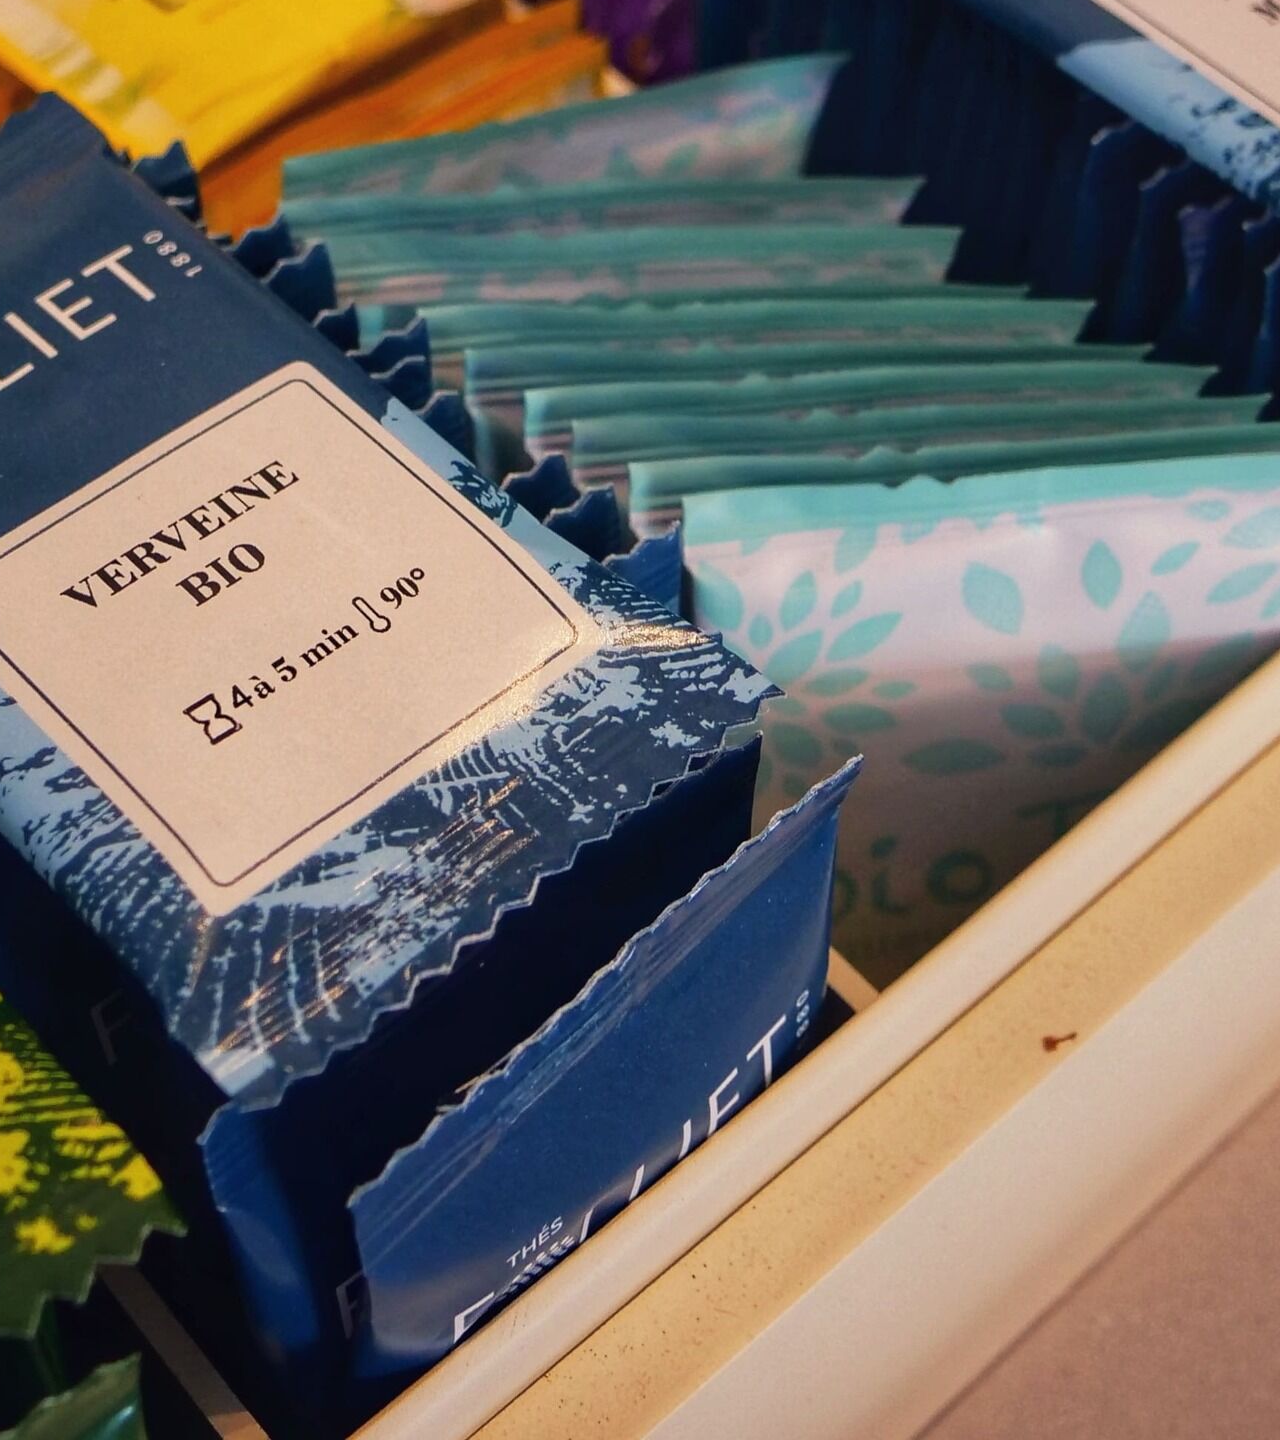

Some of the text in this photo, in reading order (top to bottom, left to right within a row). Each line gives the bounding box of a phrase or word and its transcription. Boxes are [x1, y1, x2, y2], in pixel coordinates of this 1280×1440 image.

[142, 228, 204, 279] 1880
[59, 459, 300, 610] VERVEINE
[175, 541, 268, 609] BIO
[273, 654, 300, 684] 5
[300, 620, 359, 668] min
[381, 566, 426, 611] 90°
[505, 1215, 563, 1268] THÉS
